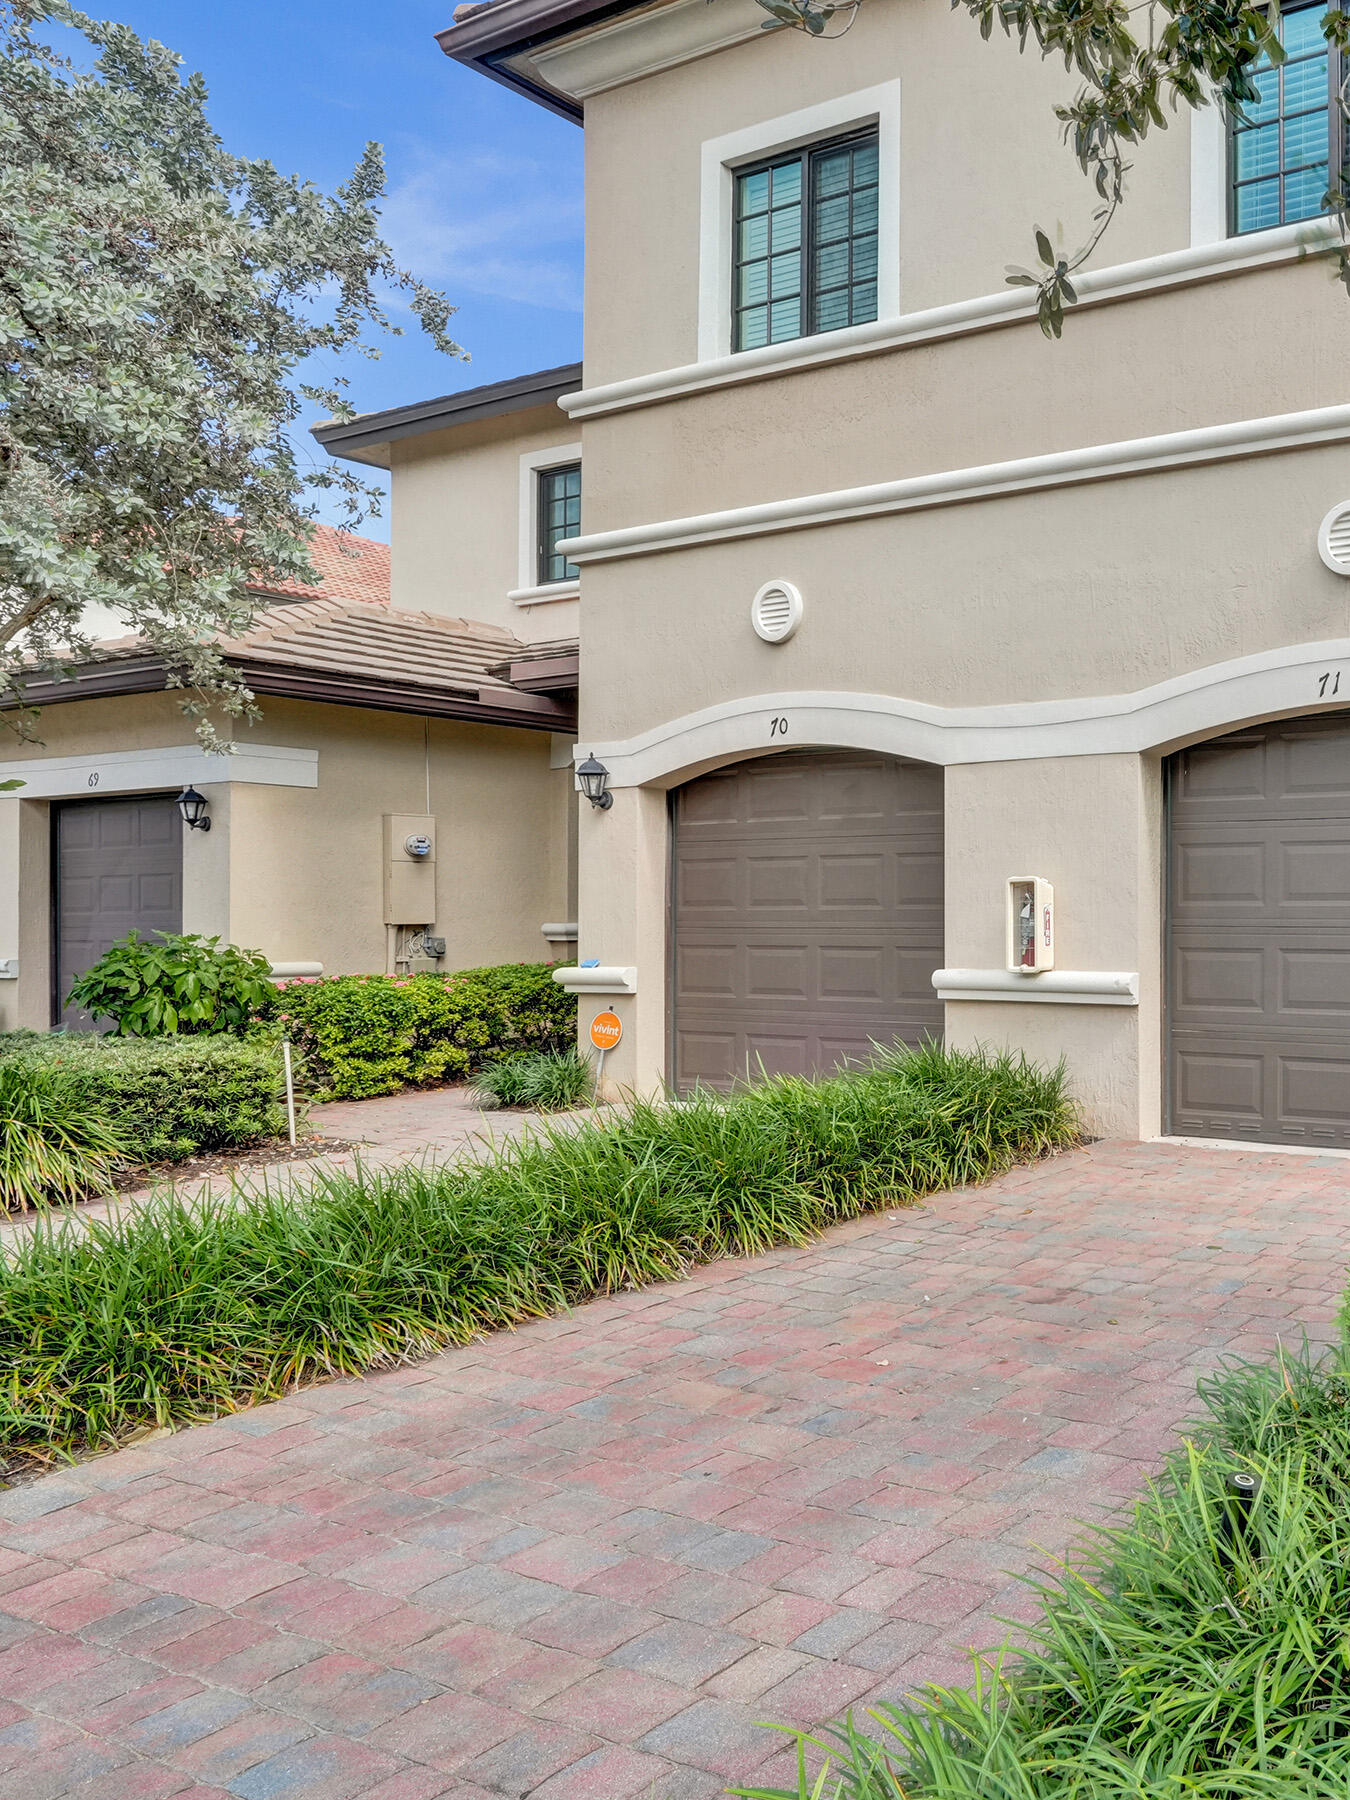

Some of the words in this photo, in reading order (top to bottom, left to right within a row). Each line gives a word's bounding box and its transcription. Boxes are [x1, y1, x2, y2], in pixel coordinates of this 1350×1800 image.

[1319, 671, 1341, 698] 71
[770, 717, 789, 737] 70
[87, 772, 100, 787] 69
[593, 1023, 620, 1036] vivint
